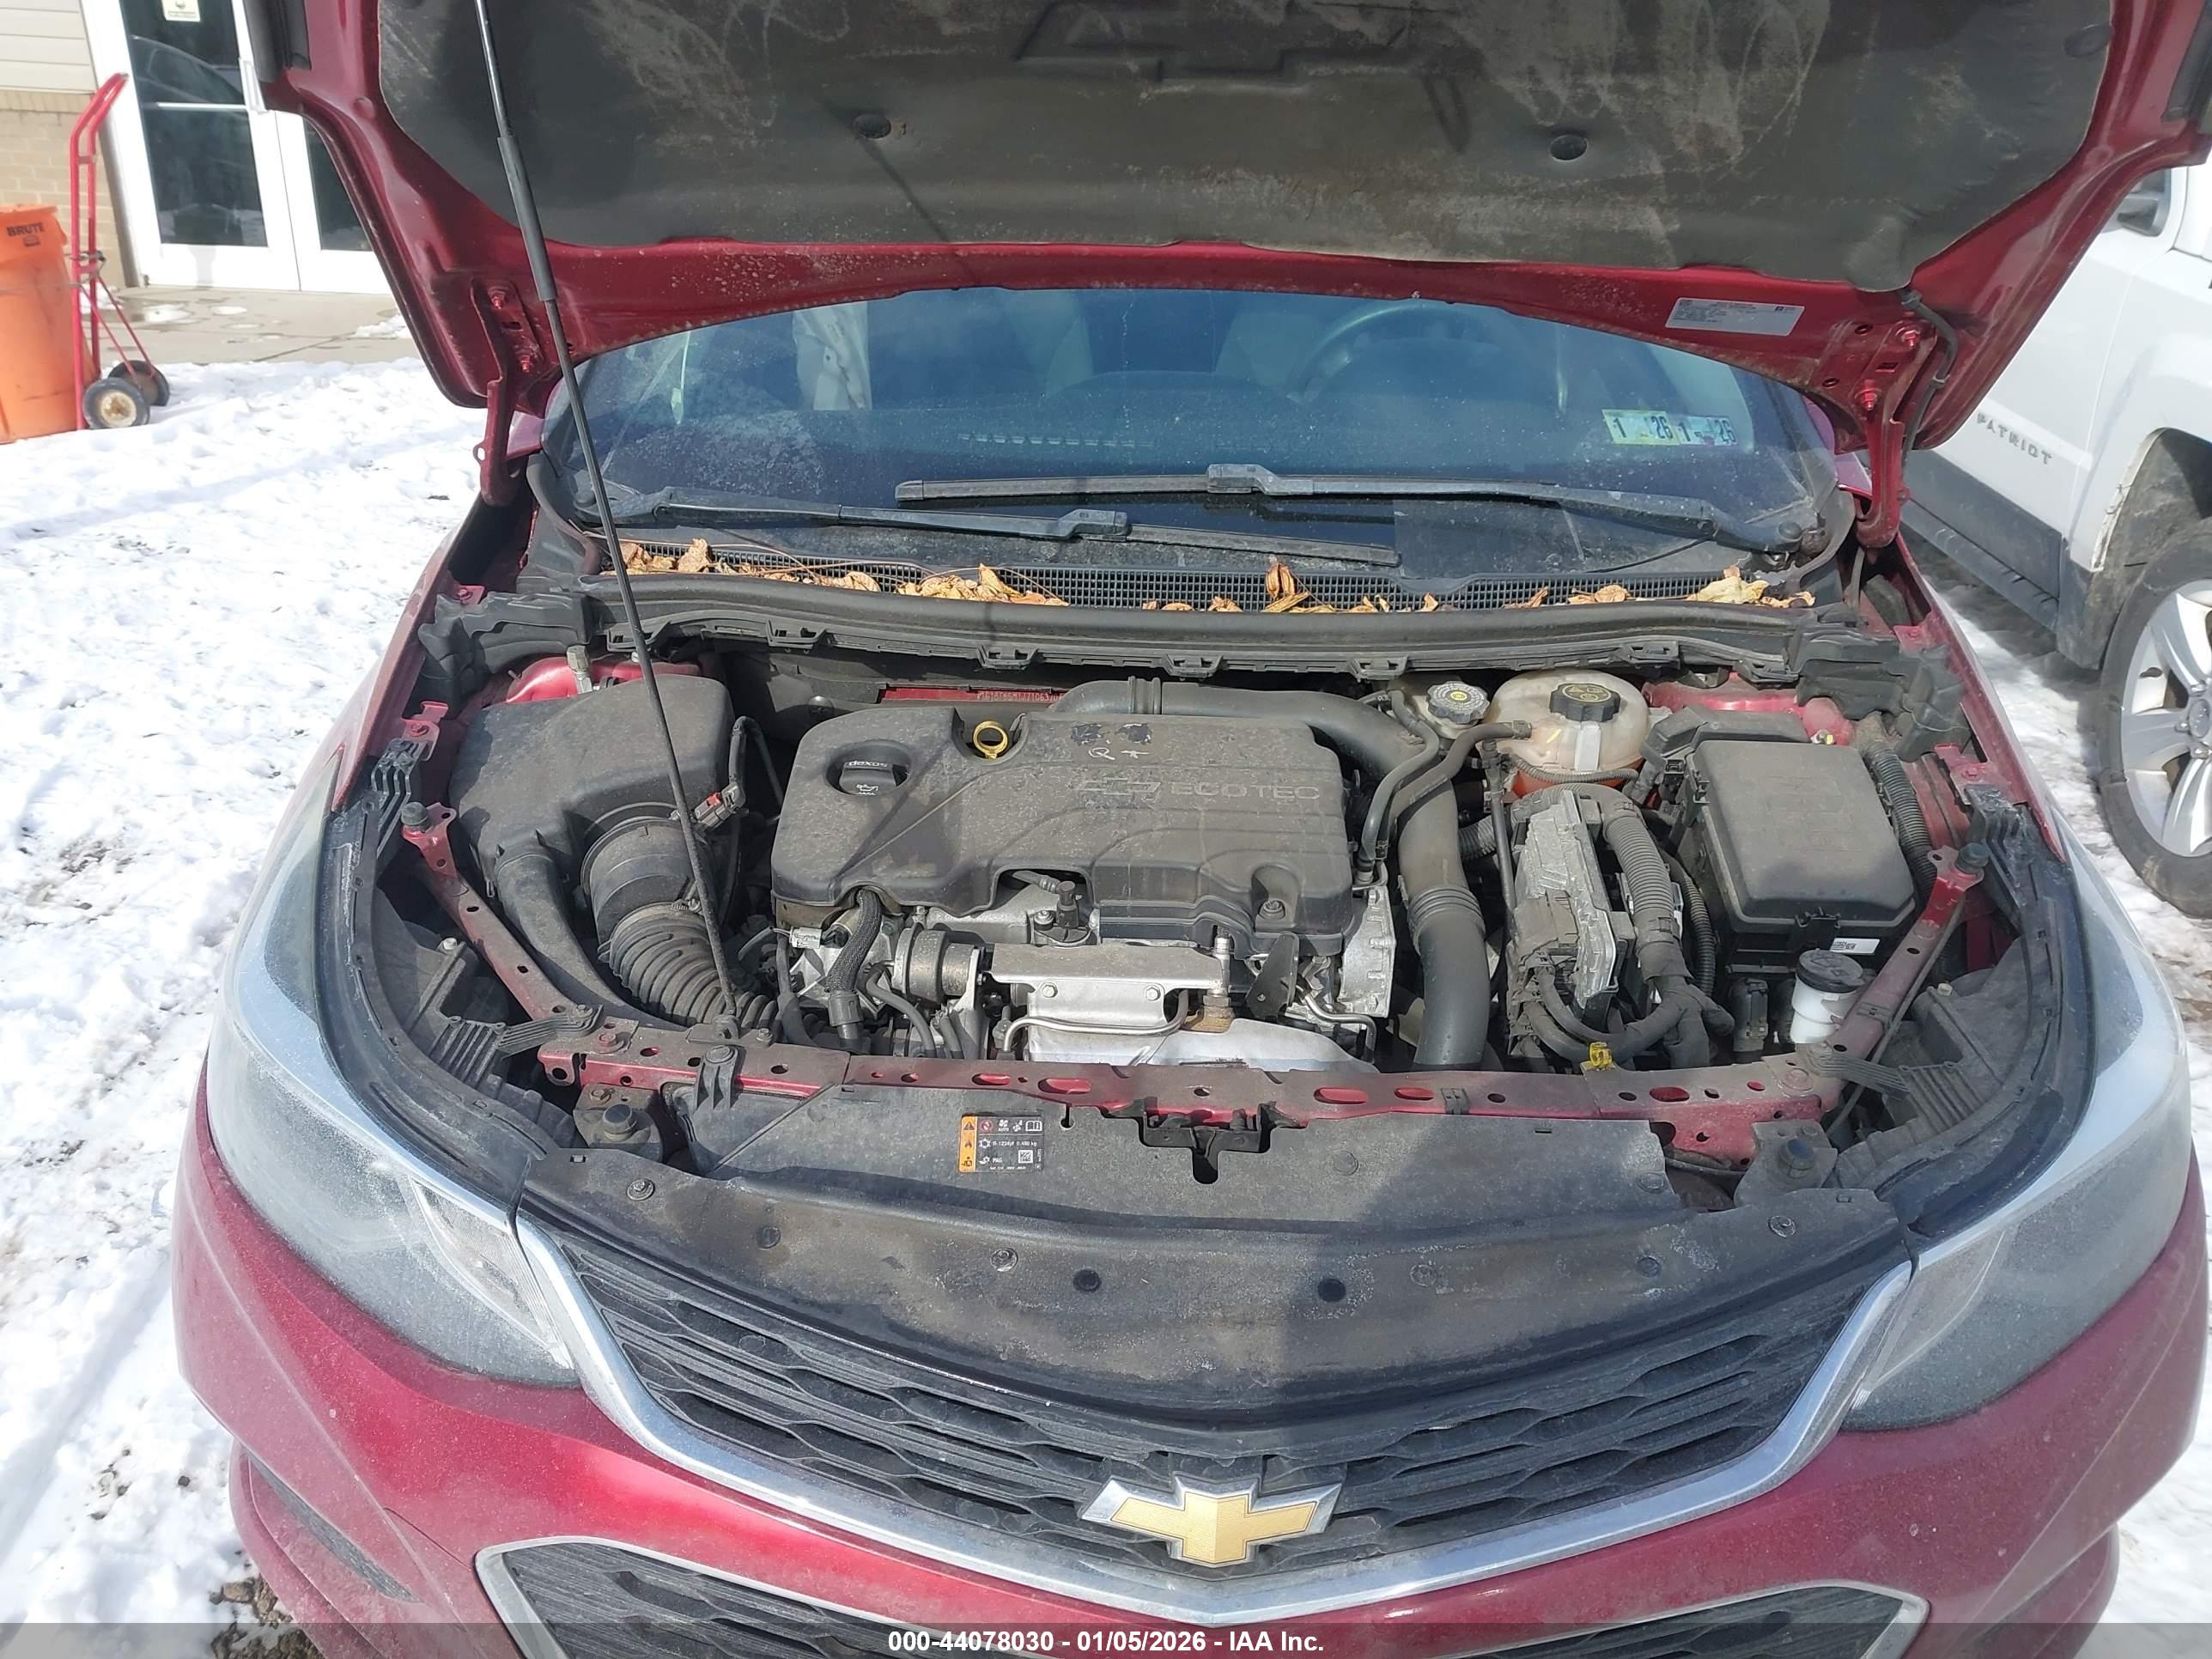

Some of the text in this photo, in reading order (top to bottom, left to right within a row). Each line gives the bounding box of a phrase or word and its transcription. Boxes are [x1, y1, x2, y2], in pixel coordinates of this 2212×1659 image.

[7, 222, 44, 237] BRUTE
[1613, 416, 1674, 439] 1 26
[1678, 422, 1691, 442] 1
[1977, 412, 2052, 465] PATRIOT
